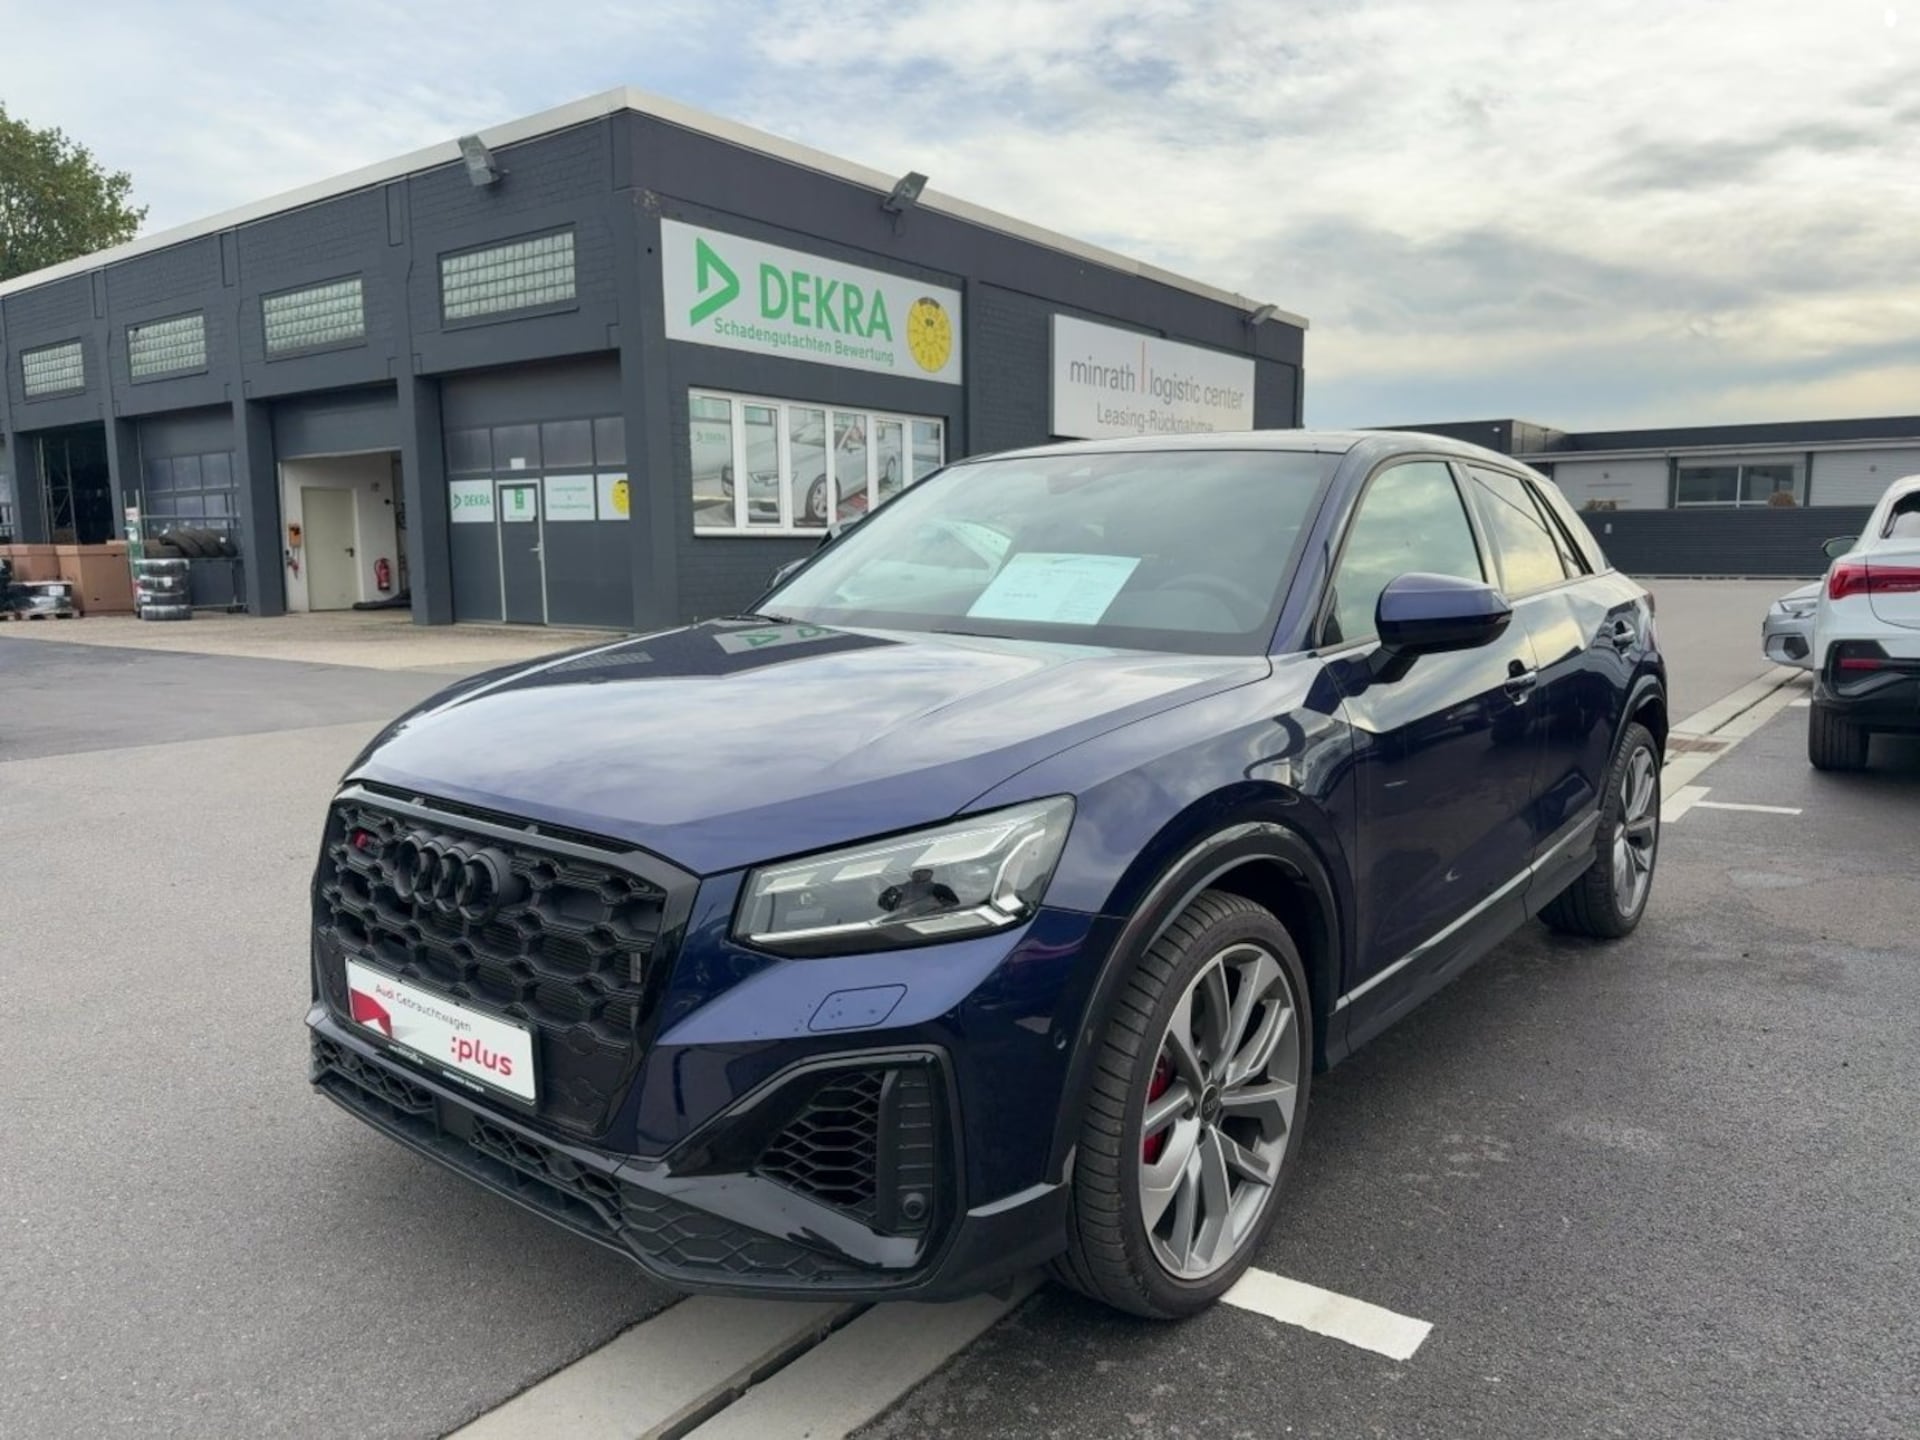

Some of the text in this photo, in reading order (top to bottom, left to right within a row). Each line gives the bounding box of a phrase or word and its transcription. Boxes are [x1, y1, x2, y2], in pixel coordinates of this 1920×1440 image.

[760, 263, 893, 342] DEKRA
[714, 317, 894, 366] Schadengutachten Bewertung
[1070, 356, 1244, 410] minrath logistic center
[464, 494, 491, 506] DEKRA
[376, 984, 472, 1032] Audi Gebrauchtwagen
